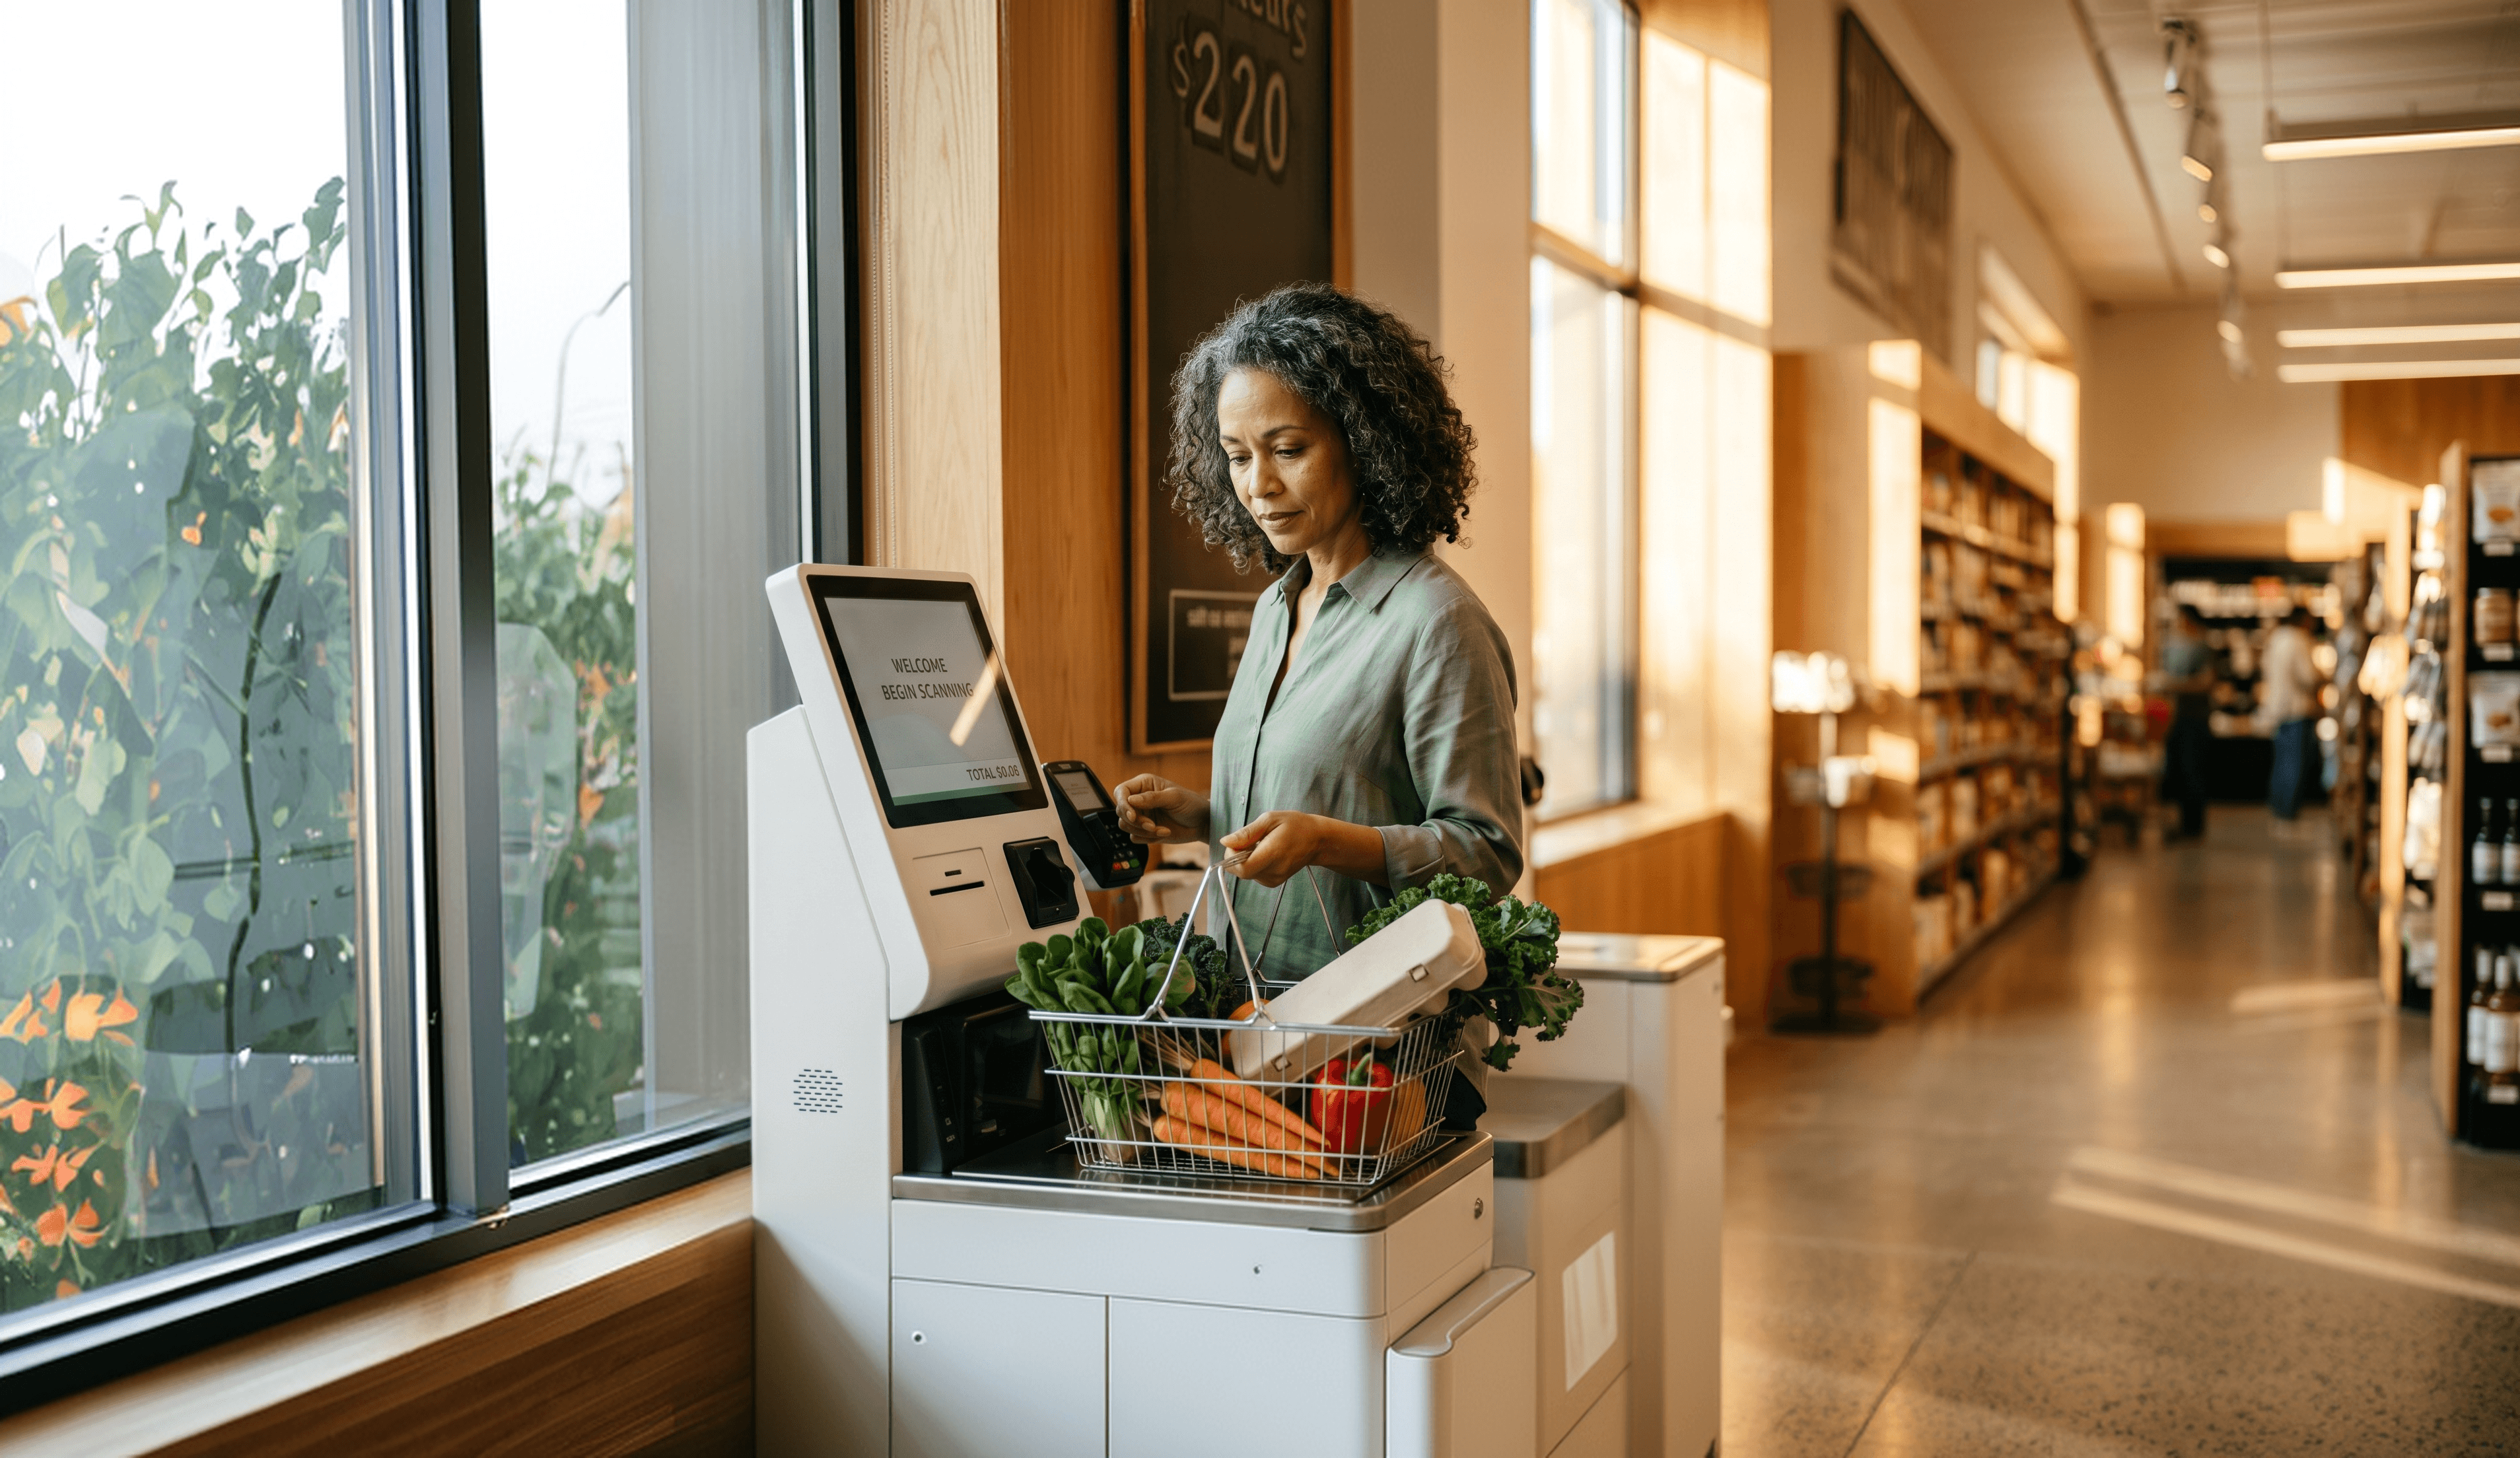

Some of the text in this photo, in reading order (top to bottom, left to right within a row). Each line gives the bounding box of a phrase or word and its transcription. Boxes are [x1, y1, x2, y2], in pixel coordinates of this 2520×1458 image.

[891, 658, 948, 673] WELCOME
[882, 683, 974, 700] BEGIN SCANNING
[966, 765, 1020, 781] TOTAL $0.06
